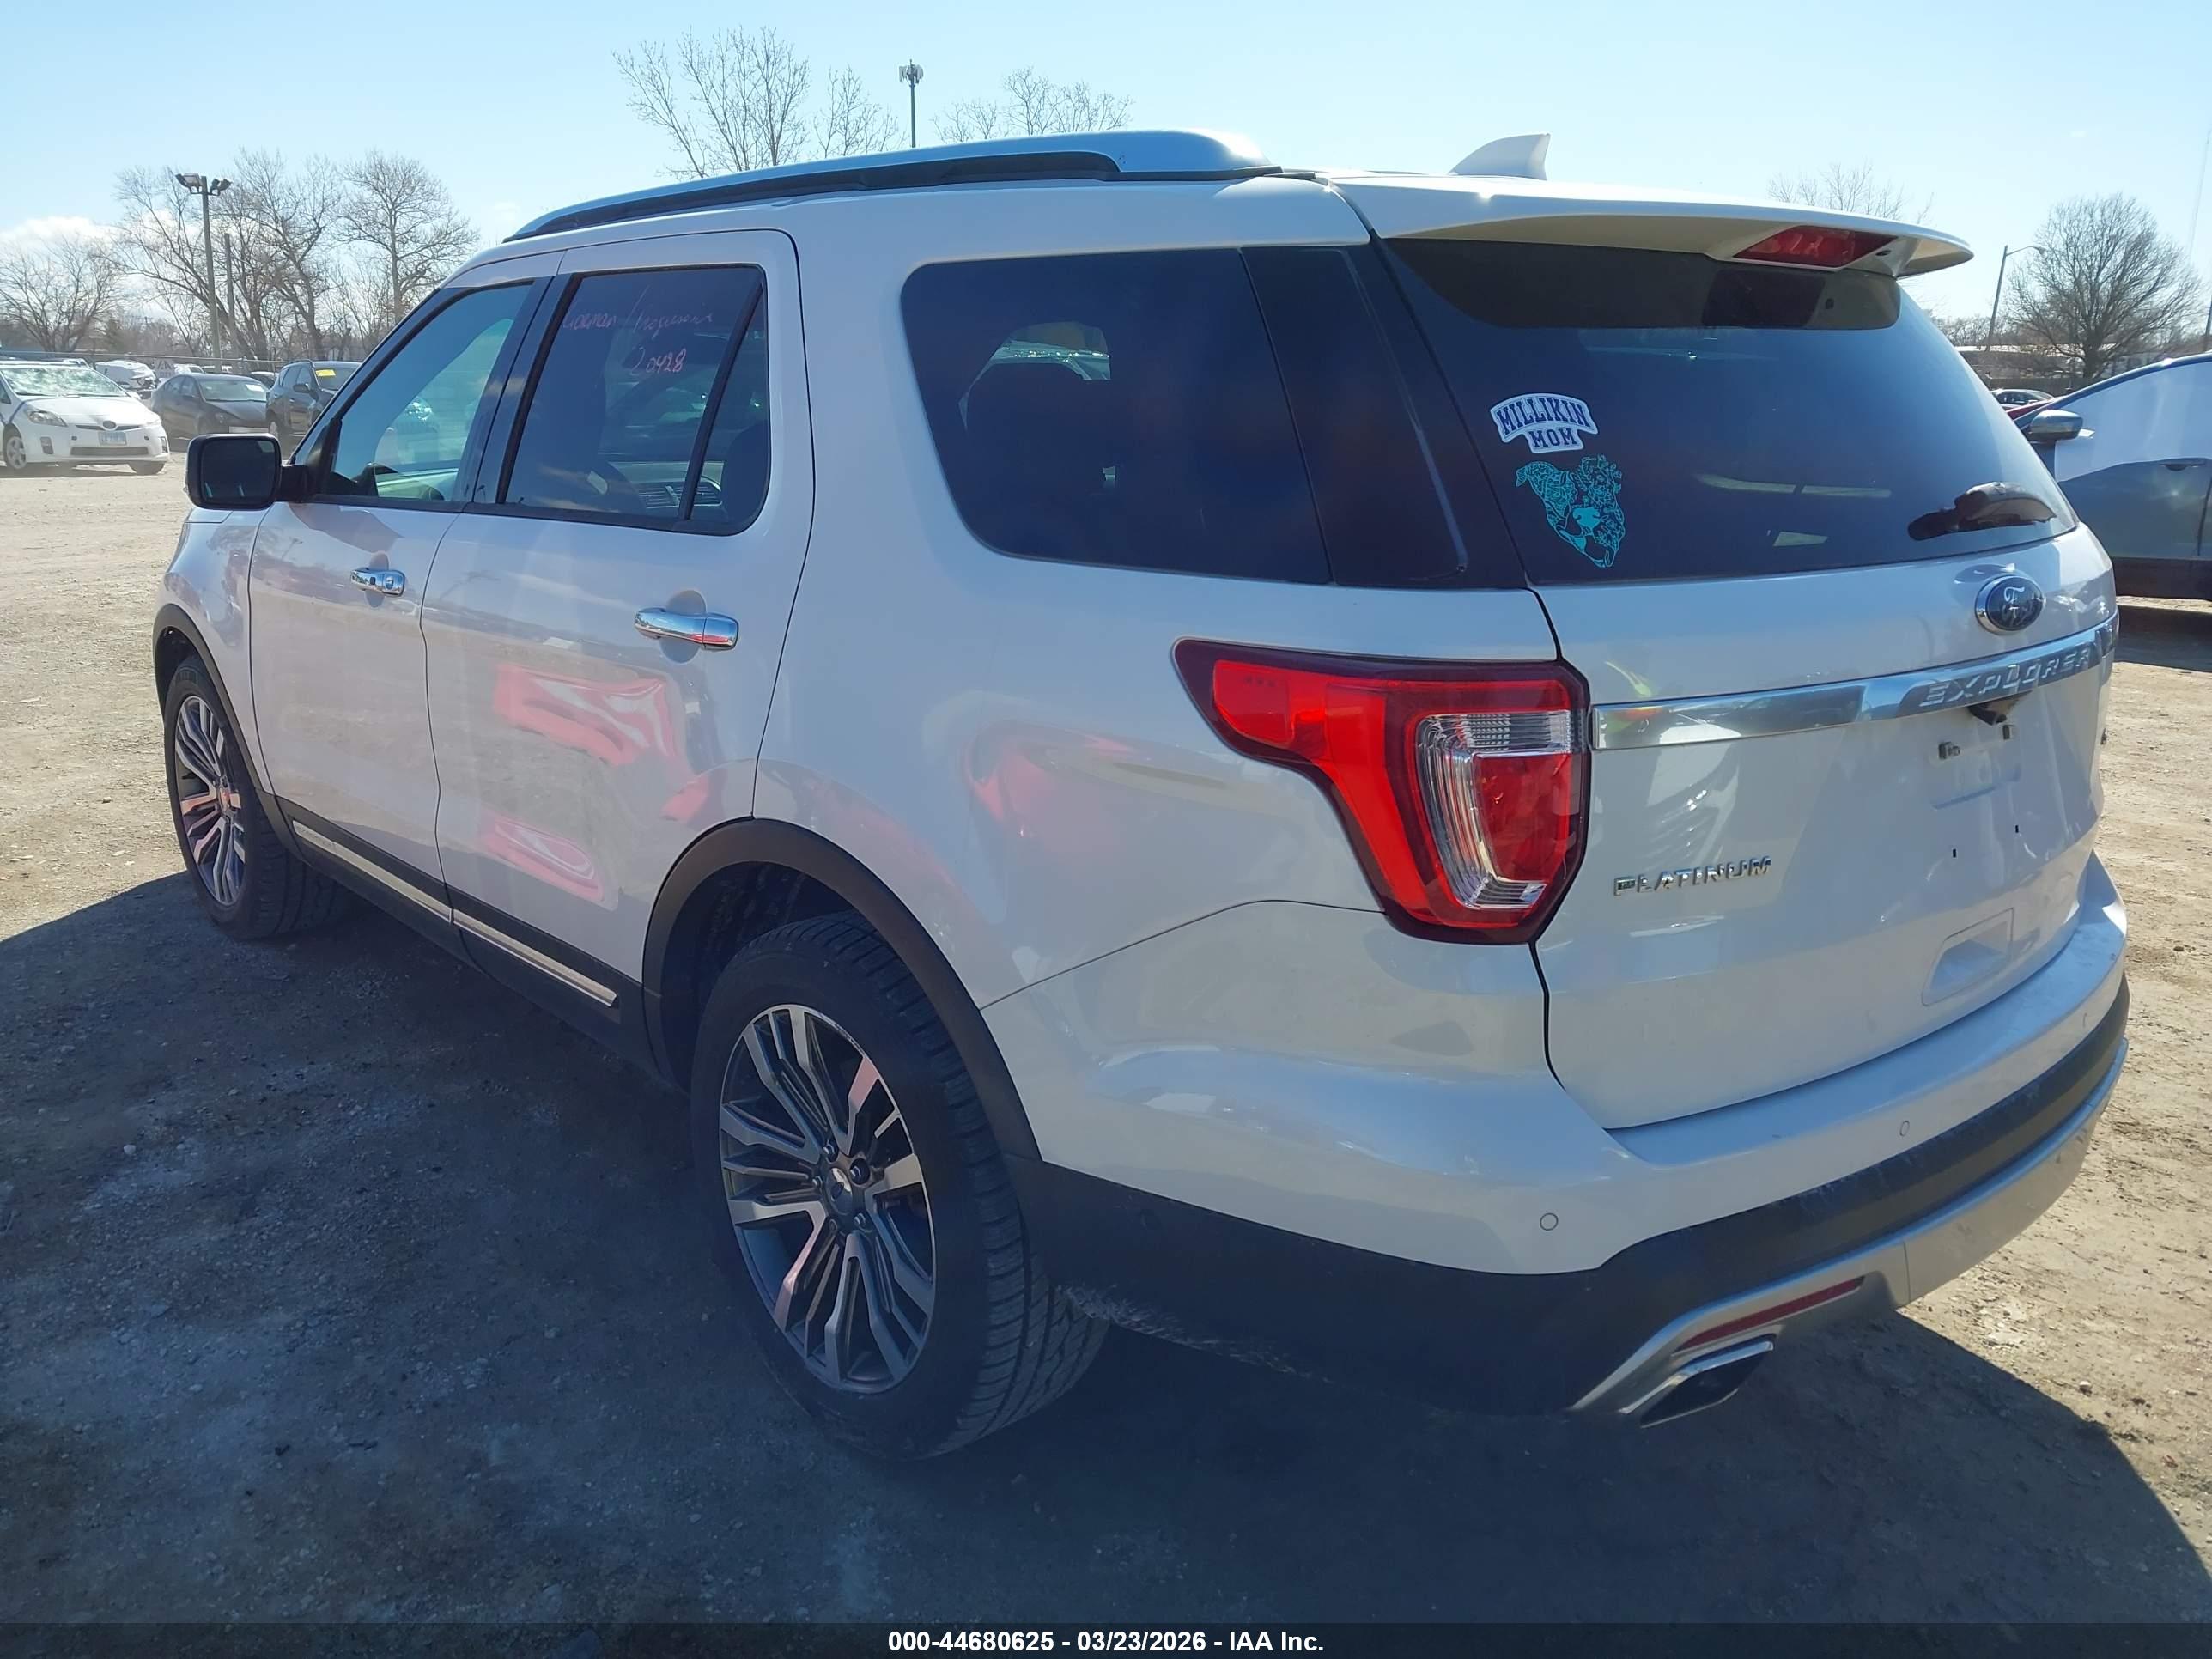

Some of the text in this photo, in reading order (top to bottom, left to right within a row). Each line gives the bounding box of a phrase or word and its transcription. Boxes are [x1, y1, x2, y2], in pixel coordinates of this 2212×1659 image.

[1496, 398, 1591, 435] MILLIKIN
[1528, 428, 1577, 448] MOM
[1918, 648, 2091, 708] EXPLORER
[1613, 856, 1771, 896] PLATINUM
